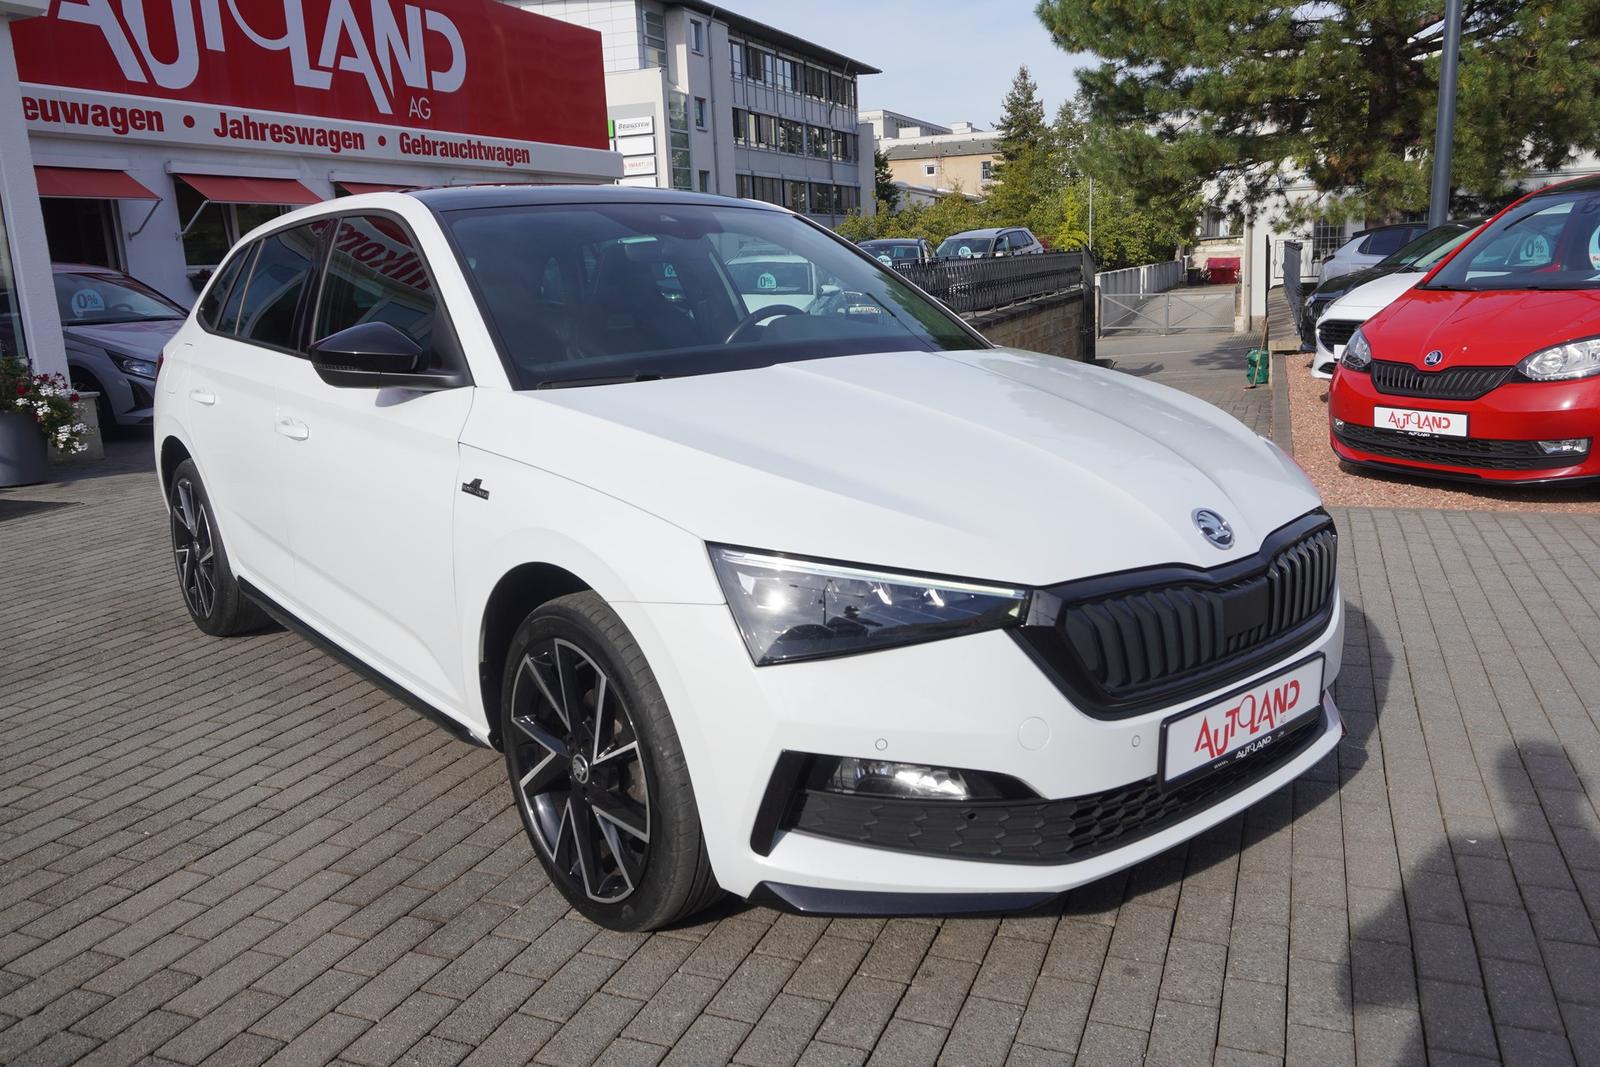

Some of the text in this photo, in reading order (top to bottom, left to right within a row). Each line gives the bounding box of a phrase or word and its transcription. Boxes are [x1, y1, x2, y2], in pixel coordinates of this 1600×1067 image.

[408, 96, 431, 120] AG
[213, 112, 365, 153] Jahreswagen
[399, 132, 531, 167] Gebrauchtwagen
[76, 293, 98, 309] 0%
[1388, 411, 1451, 432] AUTOLAND
[1193, 679, 1300, 759] AUTOLAND
